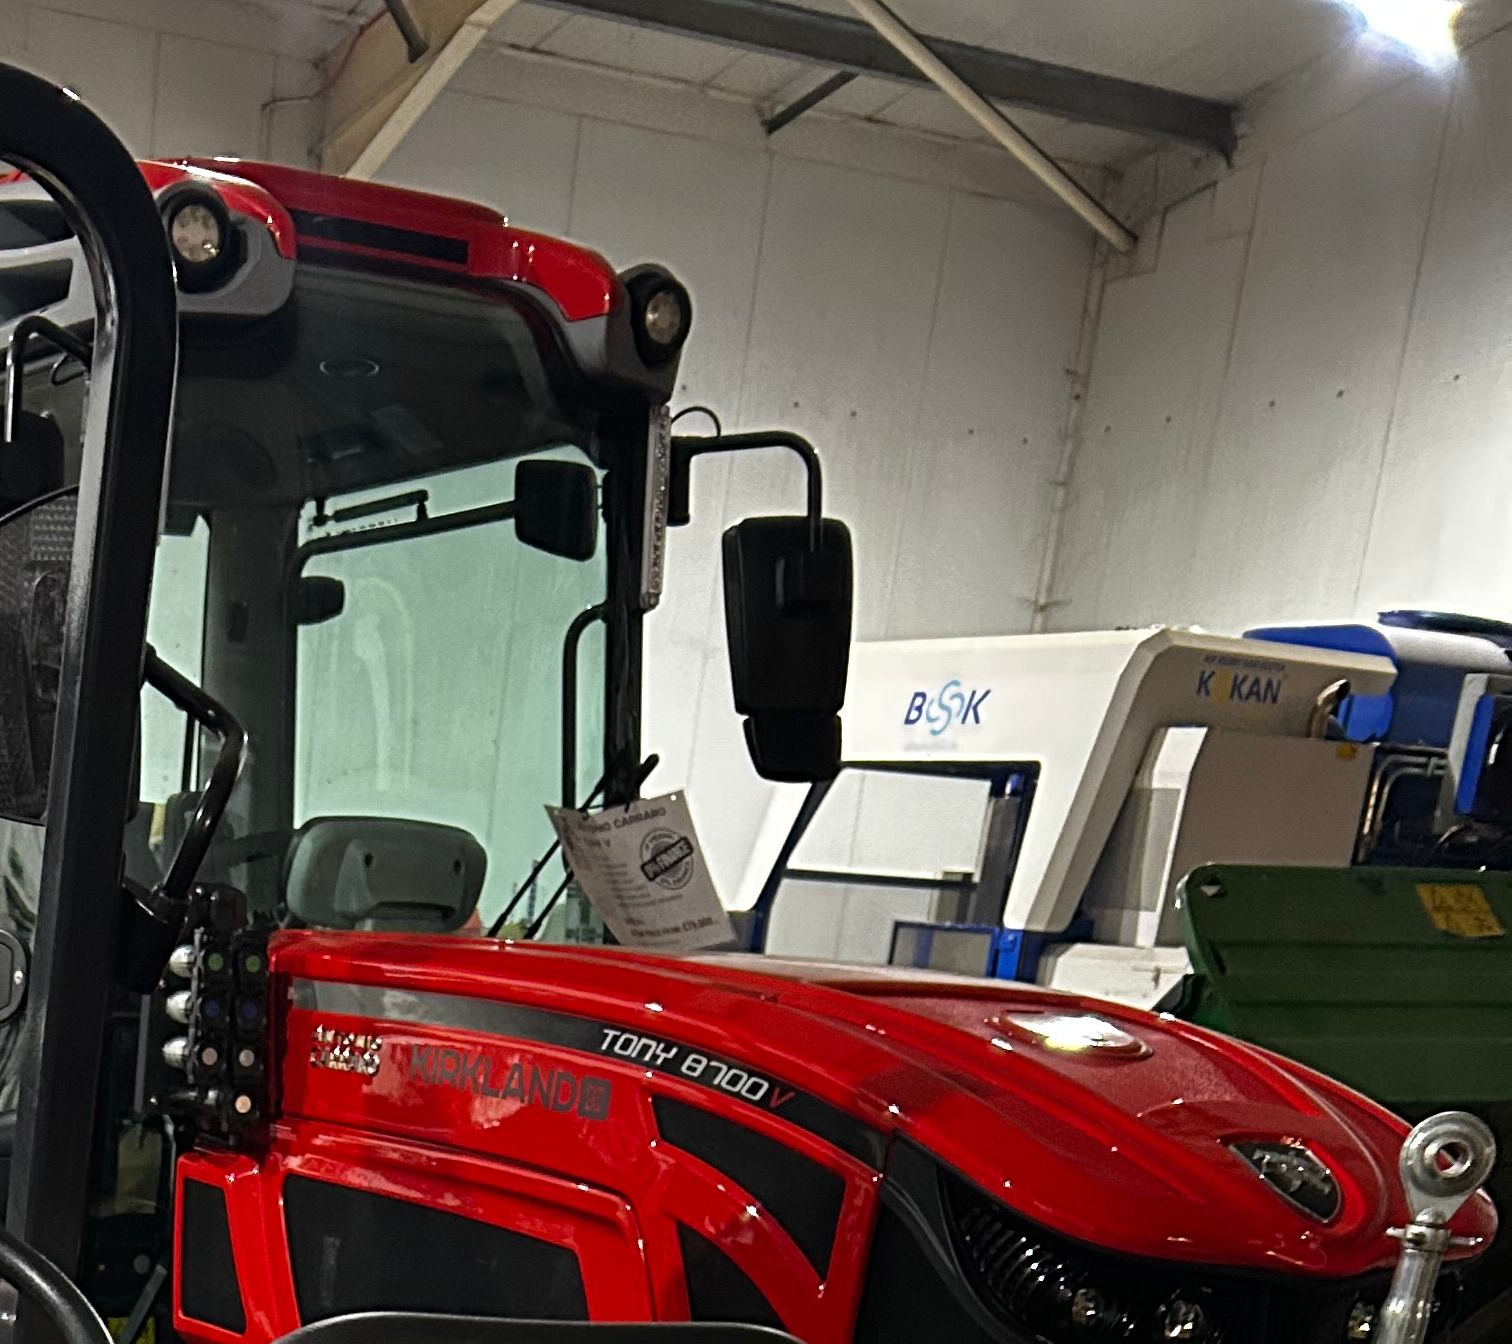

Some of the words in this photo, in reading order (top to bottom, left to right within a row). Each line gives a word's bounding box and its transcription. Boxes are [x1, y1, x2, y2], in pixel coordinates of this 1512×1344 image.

[408, 1043, 578, 1114] KIRKLAND
[600, 1028, 679, 1066] TONY
[679, 1052, 770, 1102] 8700
